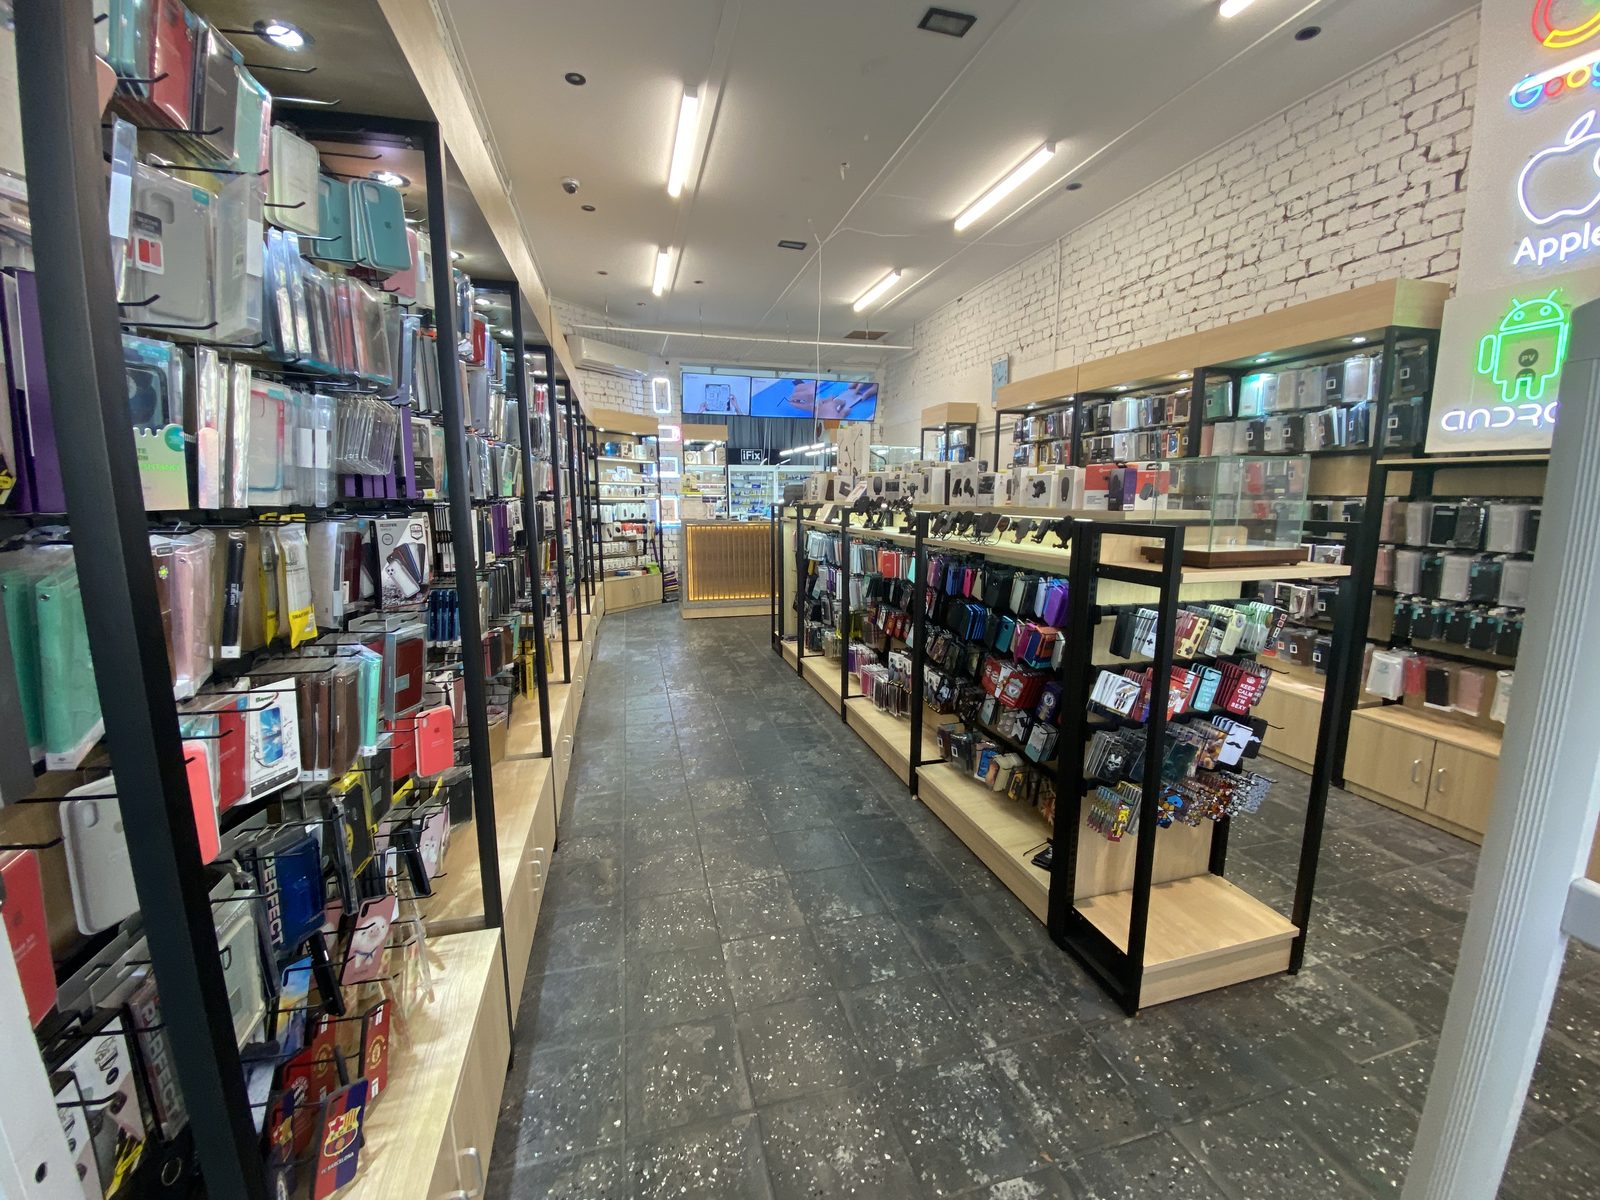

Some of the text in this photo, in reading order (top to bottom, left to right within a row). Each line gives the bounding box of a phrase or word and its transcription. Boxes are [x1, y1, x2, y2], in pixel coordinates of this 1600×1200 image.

[743, 450, 761, 460] iFix
[1240, 683, 1256, 692] KEEP
[1237, 688, 1254, 698] CALM
[1230, 702, 1247, 711] SEXY
[263, 851, 284, 944] PERFECT
